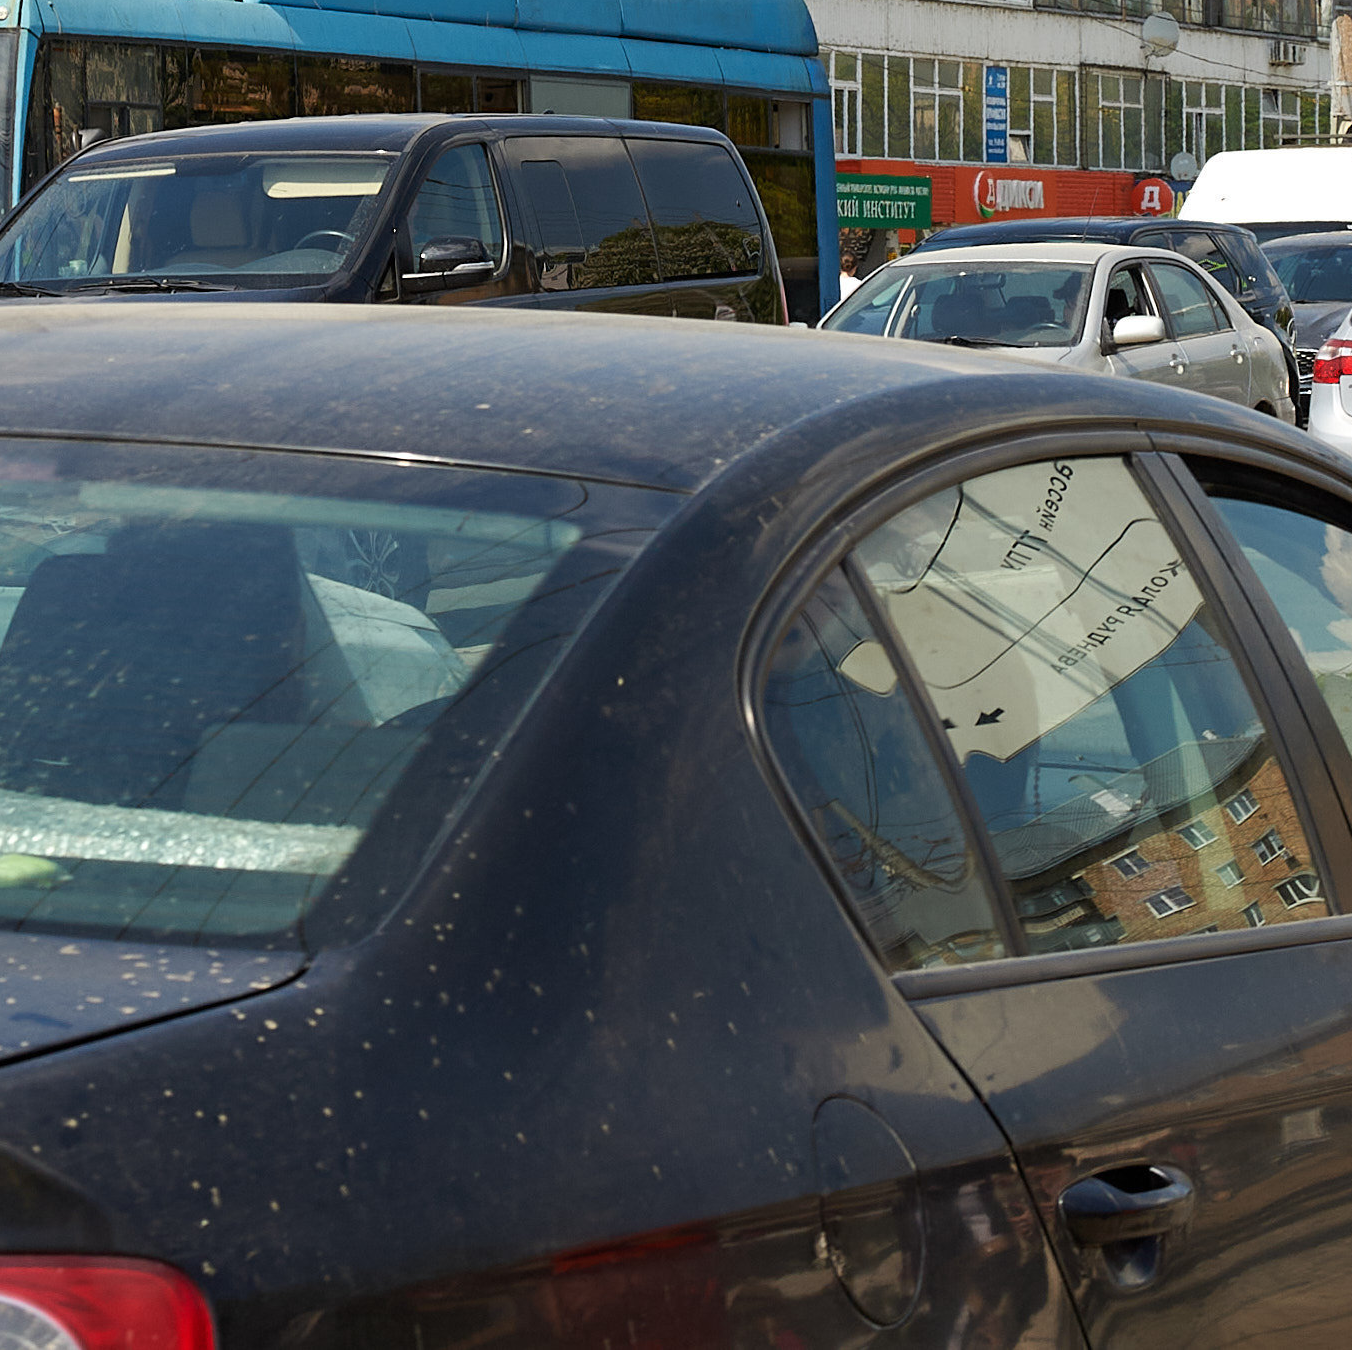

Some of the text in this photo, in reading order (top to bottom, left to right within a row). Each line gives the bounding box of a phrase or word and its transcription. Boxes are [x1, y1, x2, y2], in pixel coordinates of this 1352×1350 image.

[996, 179, 1044, 211] ДИКСИ
[1141, 186, 1161, 210] Д
[863, 200, 916, 219] ИНСТИТУТ
